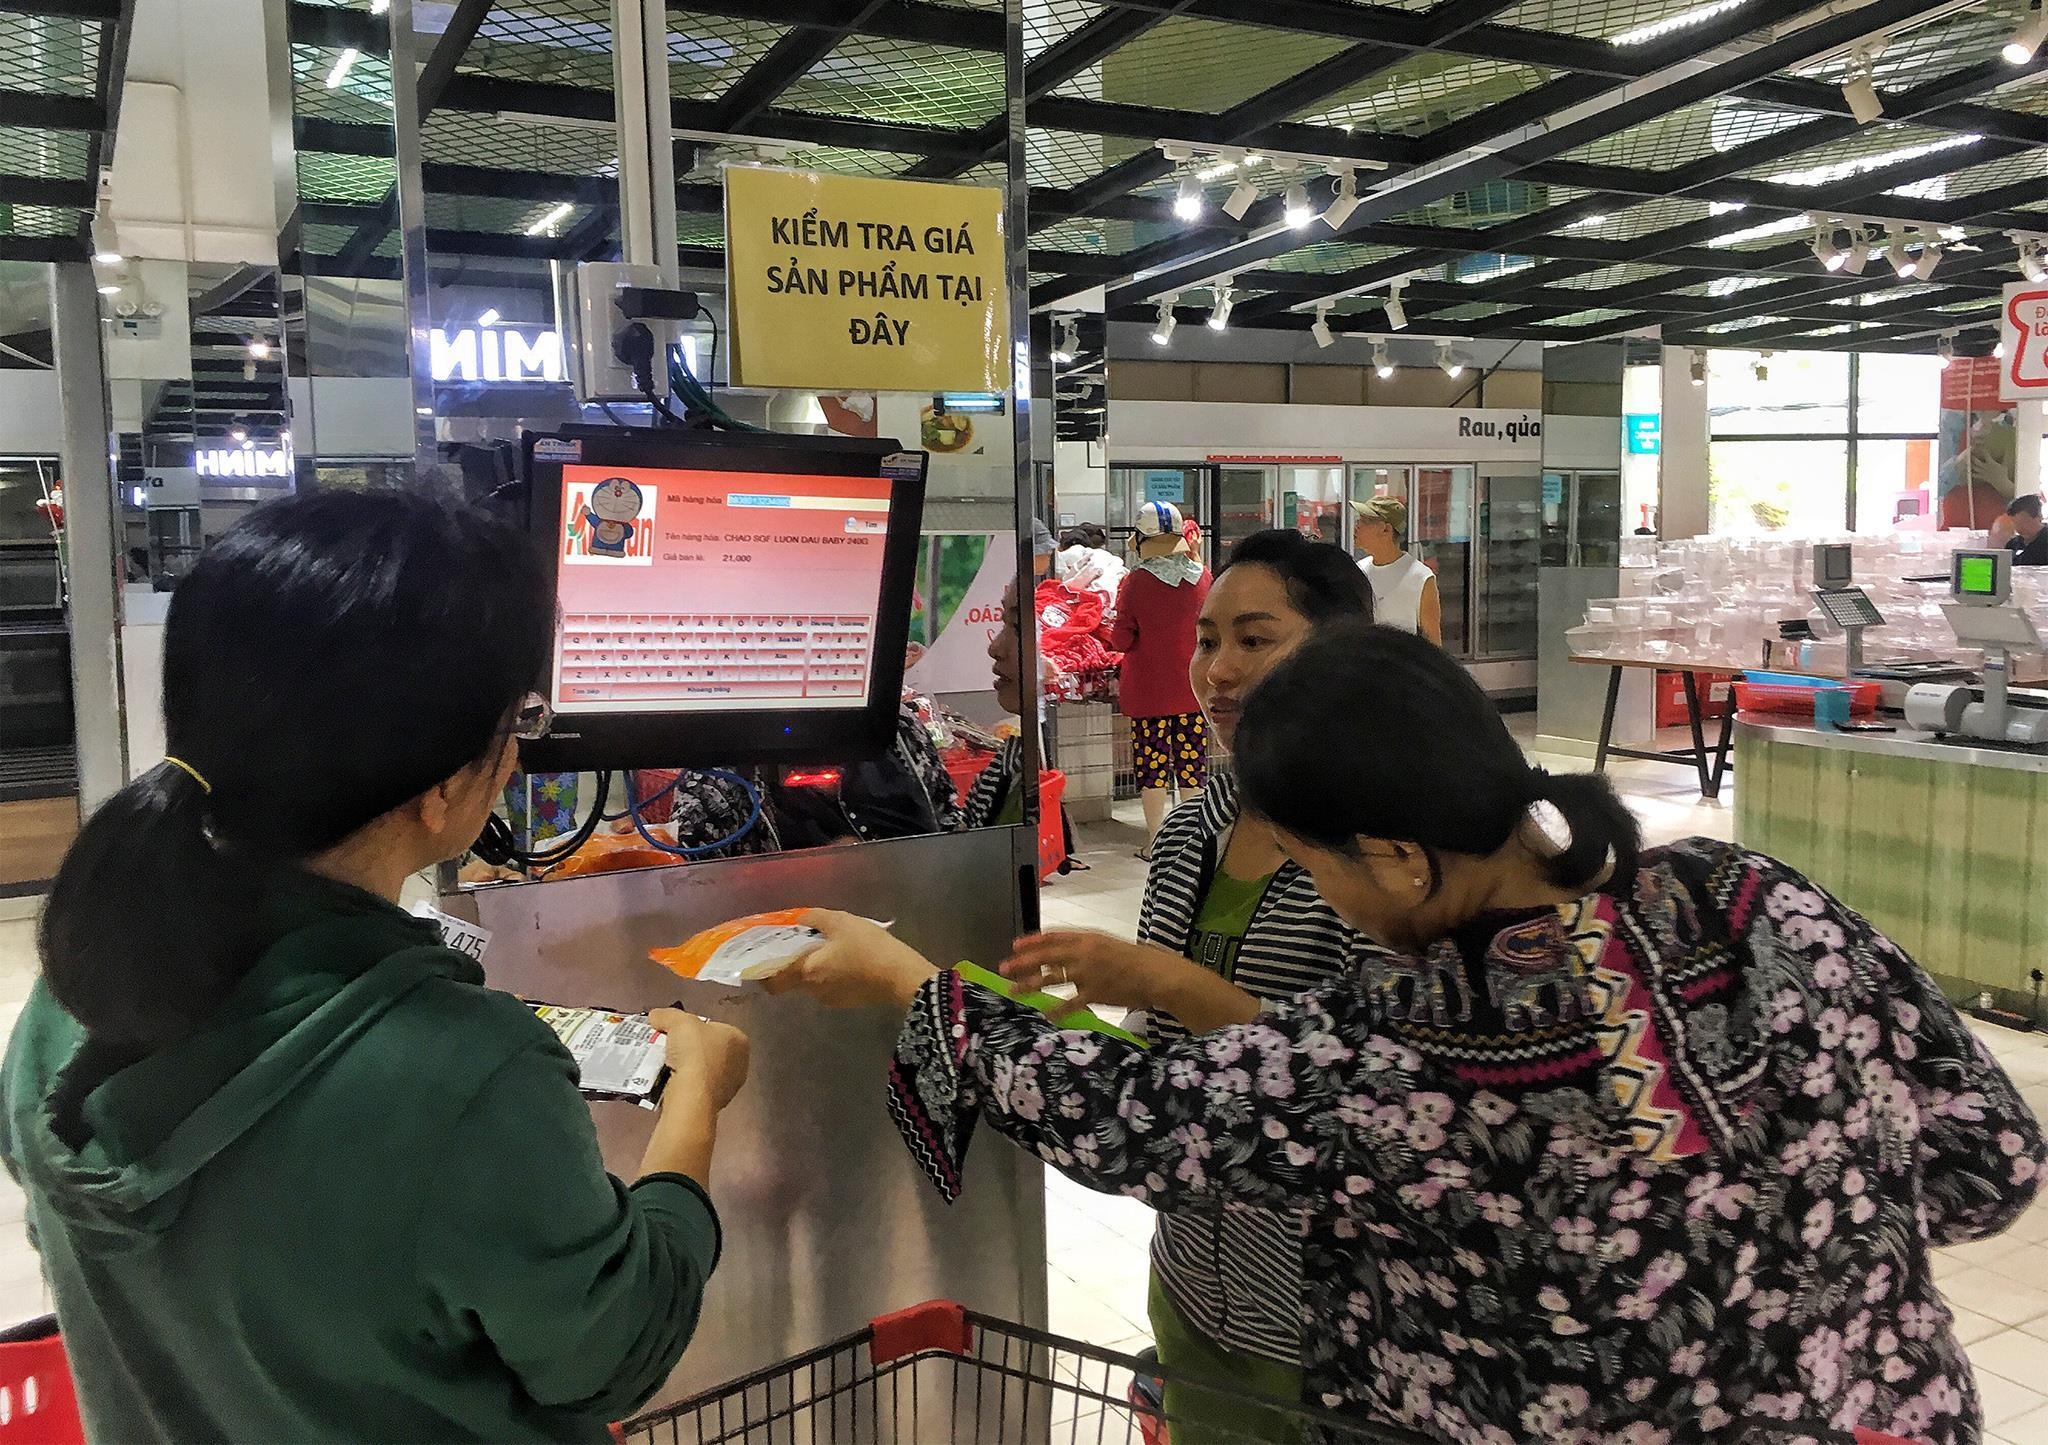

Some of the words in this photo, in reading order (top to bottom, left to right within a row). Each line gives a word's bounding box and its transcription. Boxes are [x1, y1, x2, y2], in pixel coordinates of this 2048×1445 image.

[771, 208, 848, 248] KIỂM
[857, 222, 916, 252] TRA
[924, 222, 975, 255] GIÁ
[767, 257, 828, 295] SẢN
[839, 260, 928, 300] PHẨM
[937, 273, 982, 307] TẠI
[849, 312, 910, 346] ĐÂY
